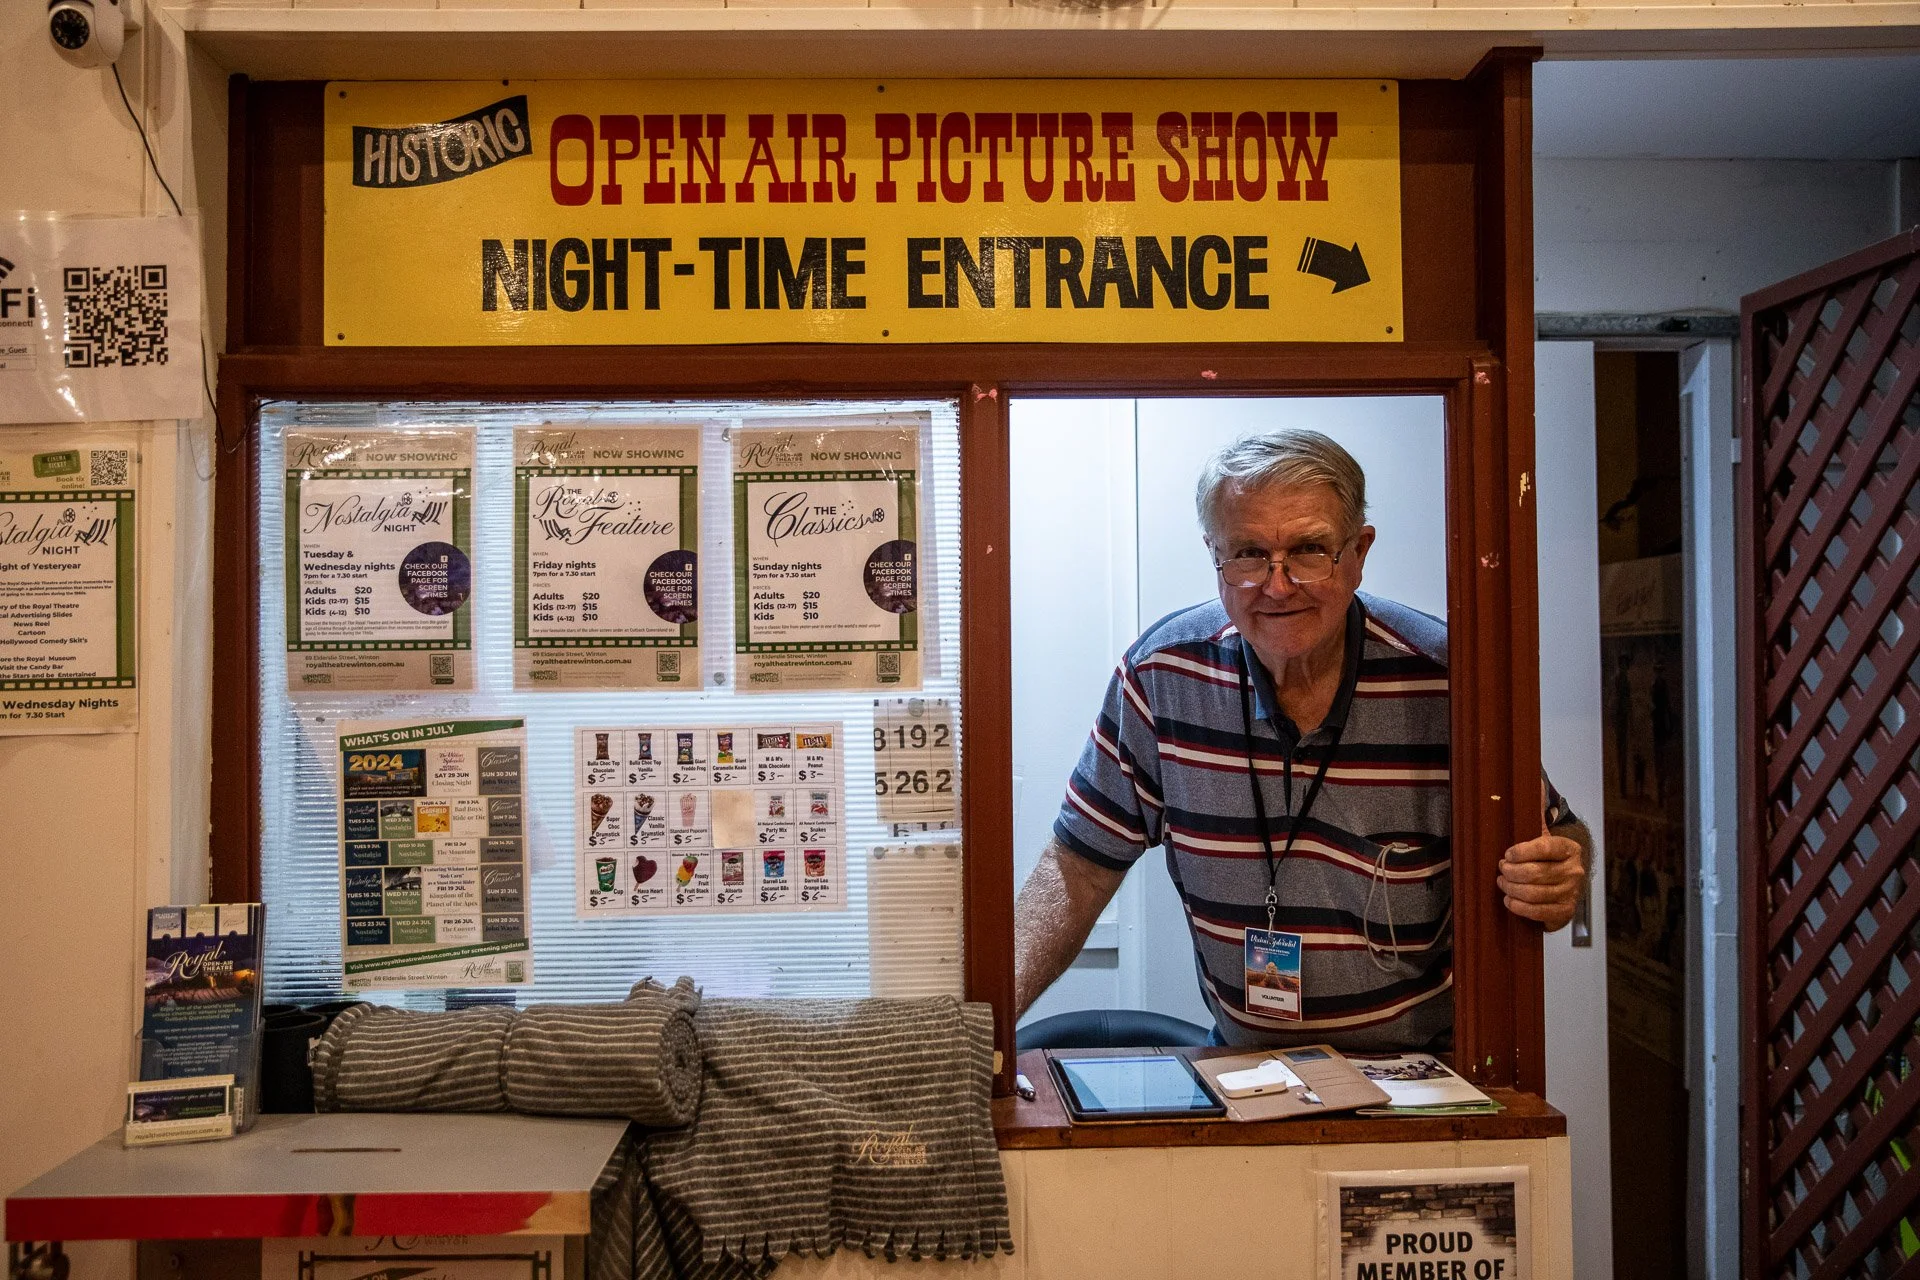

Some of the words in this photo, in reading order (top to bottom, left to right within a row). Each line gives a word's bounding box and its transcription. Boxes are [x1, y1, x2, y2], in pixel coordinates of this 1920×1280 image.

[363, 107, 526, 184] HISTORIC
[550, 113, 726, 206] OPEN
[735, 113, 857, 204] AIR
[875, 111, 1136, 203] PICTURE
[1157, 110, 1338, 202] SHOW
[482, 236, 867, 312] NIGHT-TIME
[907, 234, 1270, 310] ENTRANCE
[593, 450, 624, 459] NOW
[626, 450, 685, 459] SHOWING
[738, 434, 796, 469] Royal
[810, 451, 841, 461] NOW
[844, 451, 902, 461] SHOWING
[366, 452, 398, 462] NOW
[401, 452, 458, 462] SHOWING
[303, 494, 410, 534] Nostalgia
[814, 506, 837, 515] THE
[763, 491, 867, 548] Classics
[384, 524, 417, 532] NIGHT
[565, 506, 676, 545] Feature
[42, 545, 80, 555] NIGHT
[303, 550, 345, 560] Tuesday
[33, 562, 82, 572] Yesteryear
[303, 562, 362, 572] Wednesday
[364, 562, 396, 572] nights
[533, 561, 563, 571] Friday
[565, 561, 597, 571] nights
[753, 562, 789, 573] Sunday
[791, 562, 822, 572] nights
[871, 568, 912, 576] FACEBOOK
[304, 586, 337, 595] Adults
[354, 586, 373, 595] $20
[753, 591, 785, 600] Adults
[802, 591, 820, 600] $20
[304, 596, 327, 605] Kids
[328, 597, 349, 606] (12-17)
[354, 596, 370, 605] $15
[533, 592, 565, 601] Adults
[582, 592, 600, 601] $20
[32, 603, 52, 611] Royal
[304, 606, 327, 616] Kids
[328, 609, 348, 617] (4-12)
[354, 606, 371, 616] $10
[533, 603, 554, 611] Kids
[556, 604, 576, 612] (12-17)
[582, 602, 598, 611] $15
[753, 602, 775, 610] Kids
[776, 603, 797, 611] (12-17)
[802, 602, 818, 610] $15
[10, 611, 51, 619] Advertising
[533, 613, 554, 622] Kids
[556, 615, 575, 623] (4-12)
[582, 613, 598, 622] $10
[753, 612, 775, 621] Kids
[802, 612, 819, 621] $10
[39, 637, 68, 645] Comedy
[305, 661, 405, 670] royaltheatrewinton.com.au
[532, 657, 632, 667] royaltheatrewinton.com.au
[753, 659, 853, 669] royaltheatrewinton.com.au
[29, 664, 51, 672] Candy
[3, 699, 76, 710] Wednesday
[78, 698, 119, 709] Nights
[344, 731, 390, 748] WHAT'S
[391, 730, 410, 742] ON
[412, 728, 425, 739] IN
[426, 723, 456, 737] JULY
[348, 753, 404, 772] 2024
[456, 778, 472, 788] Night
[471, 945, 501, 955] screening
[500, 941, 525, 951] updates
[163, 940, 227, 980] Royal
[1386, 1231, 1474, 1255] PROUD
[1356, 1260, 1467, 1280] MEMBER
[1474, 1258, 1506, 1280] OF
